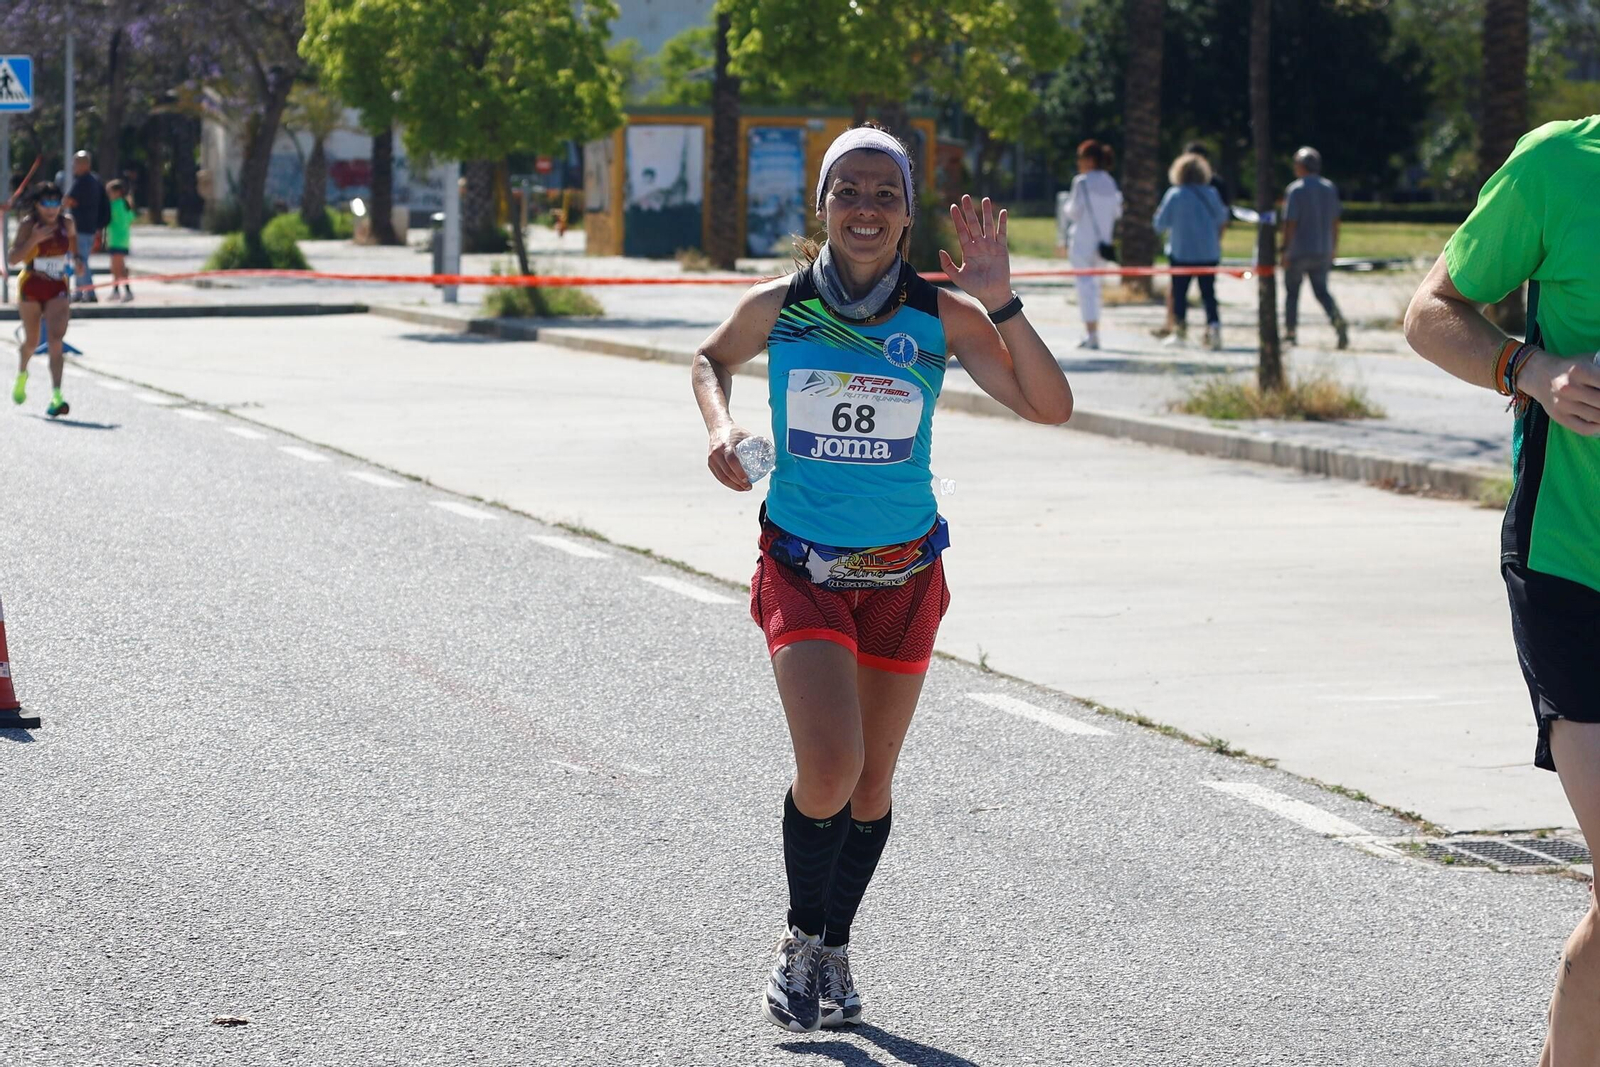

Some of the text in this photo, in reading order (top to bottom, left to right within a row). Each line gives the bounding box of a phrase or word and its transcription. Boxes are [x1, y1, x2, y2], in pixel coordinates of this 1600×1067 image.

[852, 376, 893, 387] RFEA
[848, 385, 910, 397] ATLETISMO
[832, 403, 875, 433] 68
